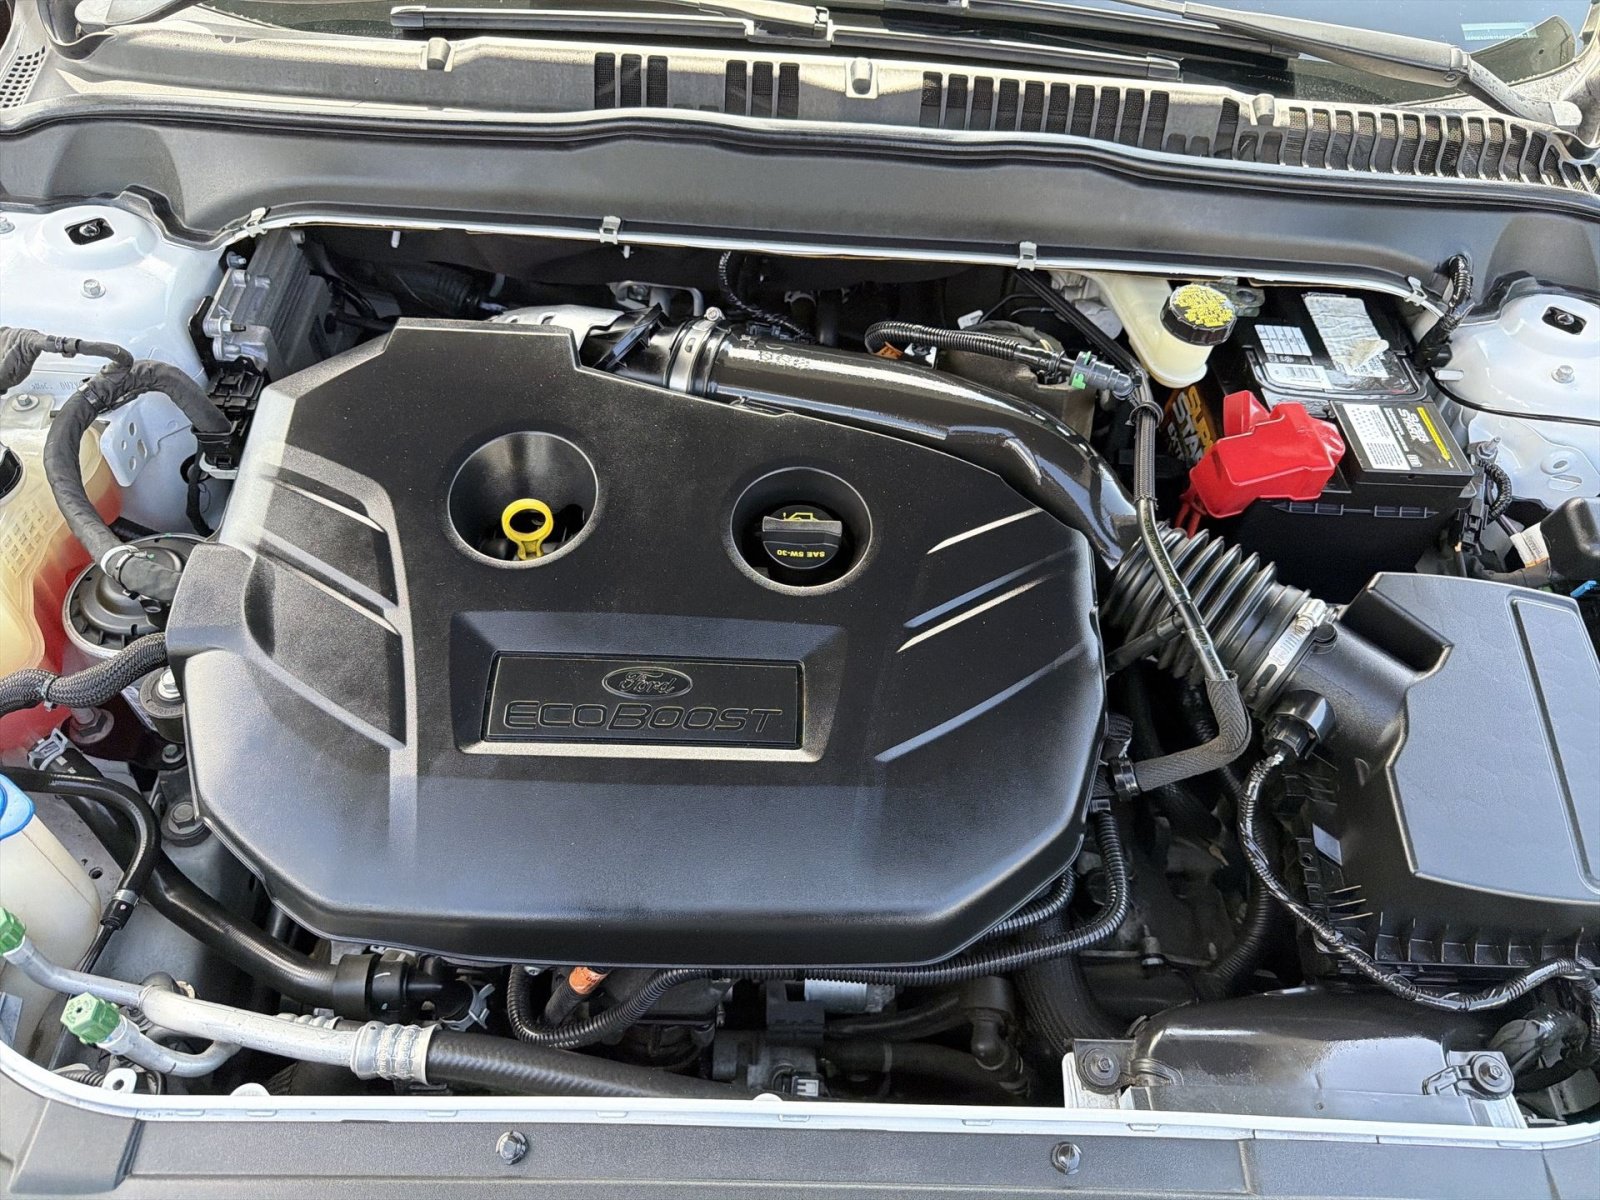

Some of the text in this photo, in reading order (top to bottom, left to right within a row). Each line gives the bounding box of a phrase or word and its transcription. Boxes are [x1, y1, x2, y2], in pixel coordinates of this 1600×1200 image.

[776, 549, 826, 558] SAE 5W-30
[618, 671, 677, 695] Ford
